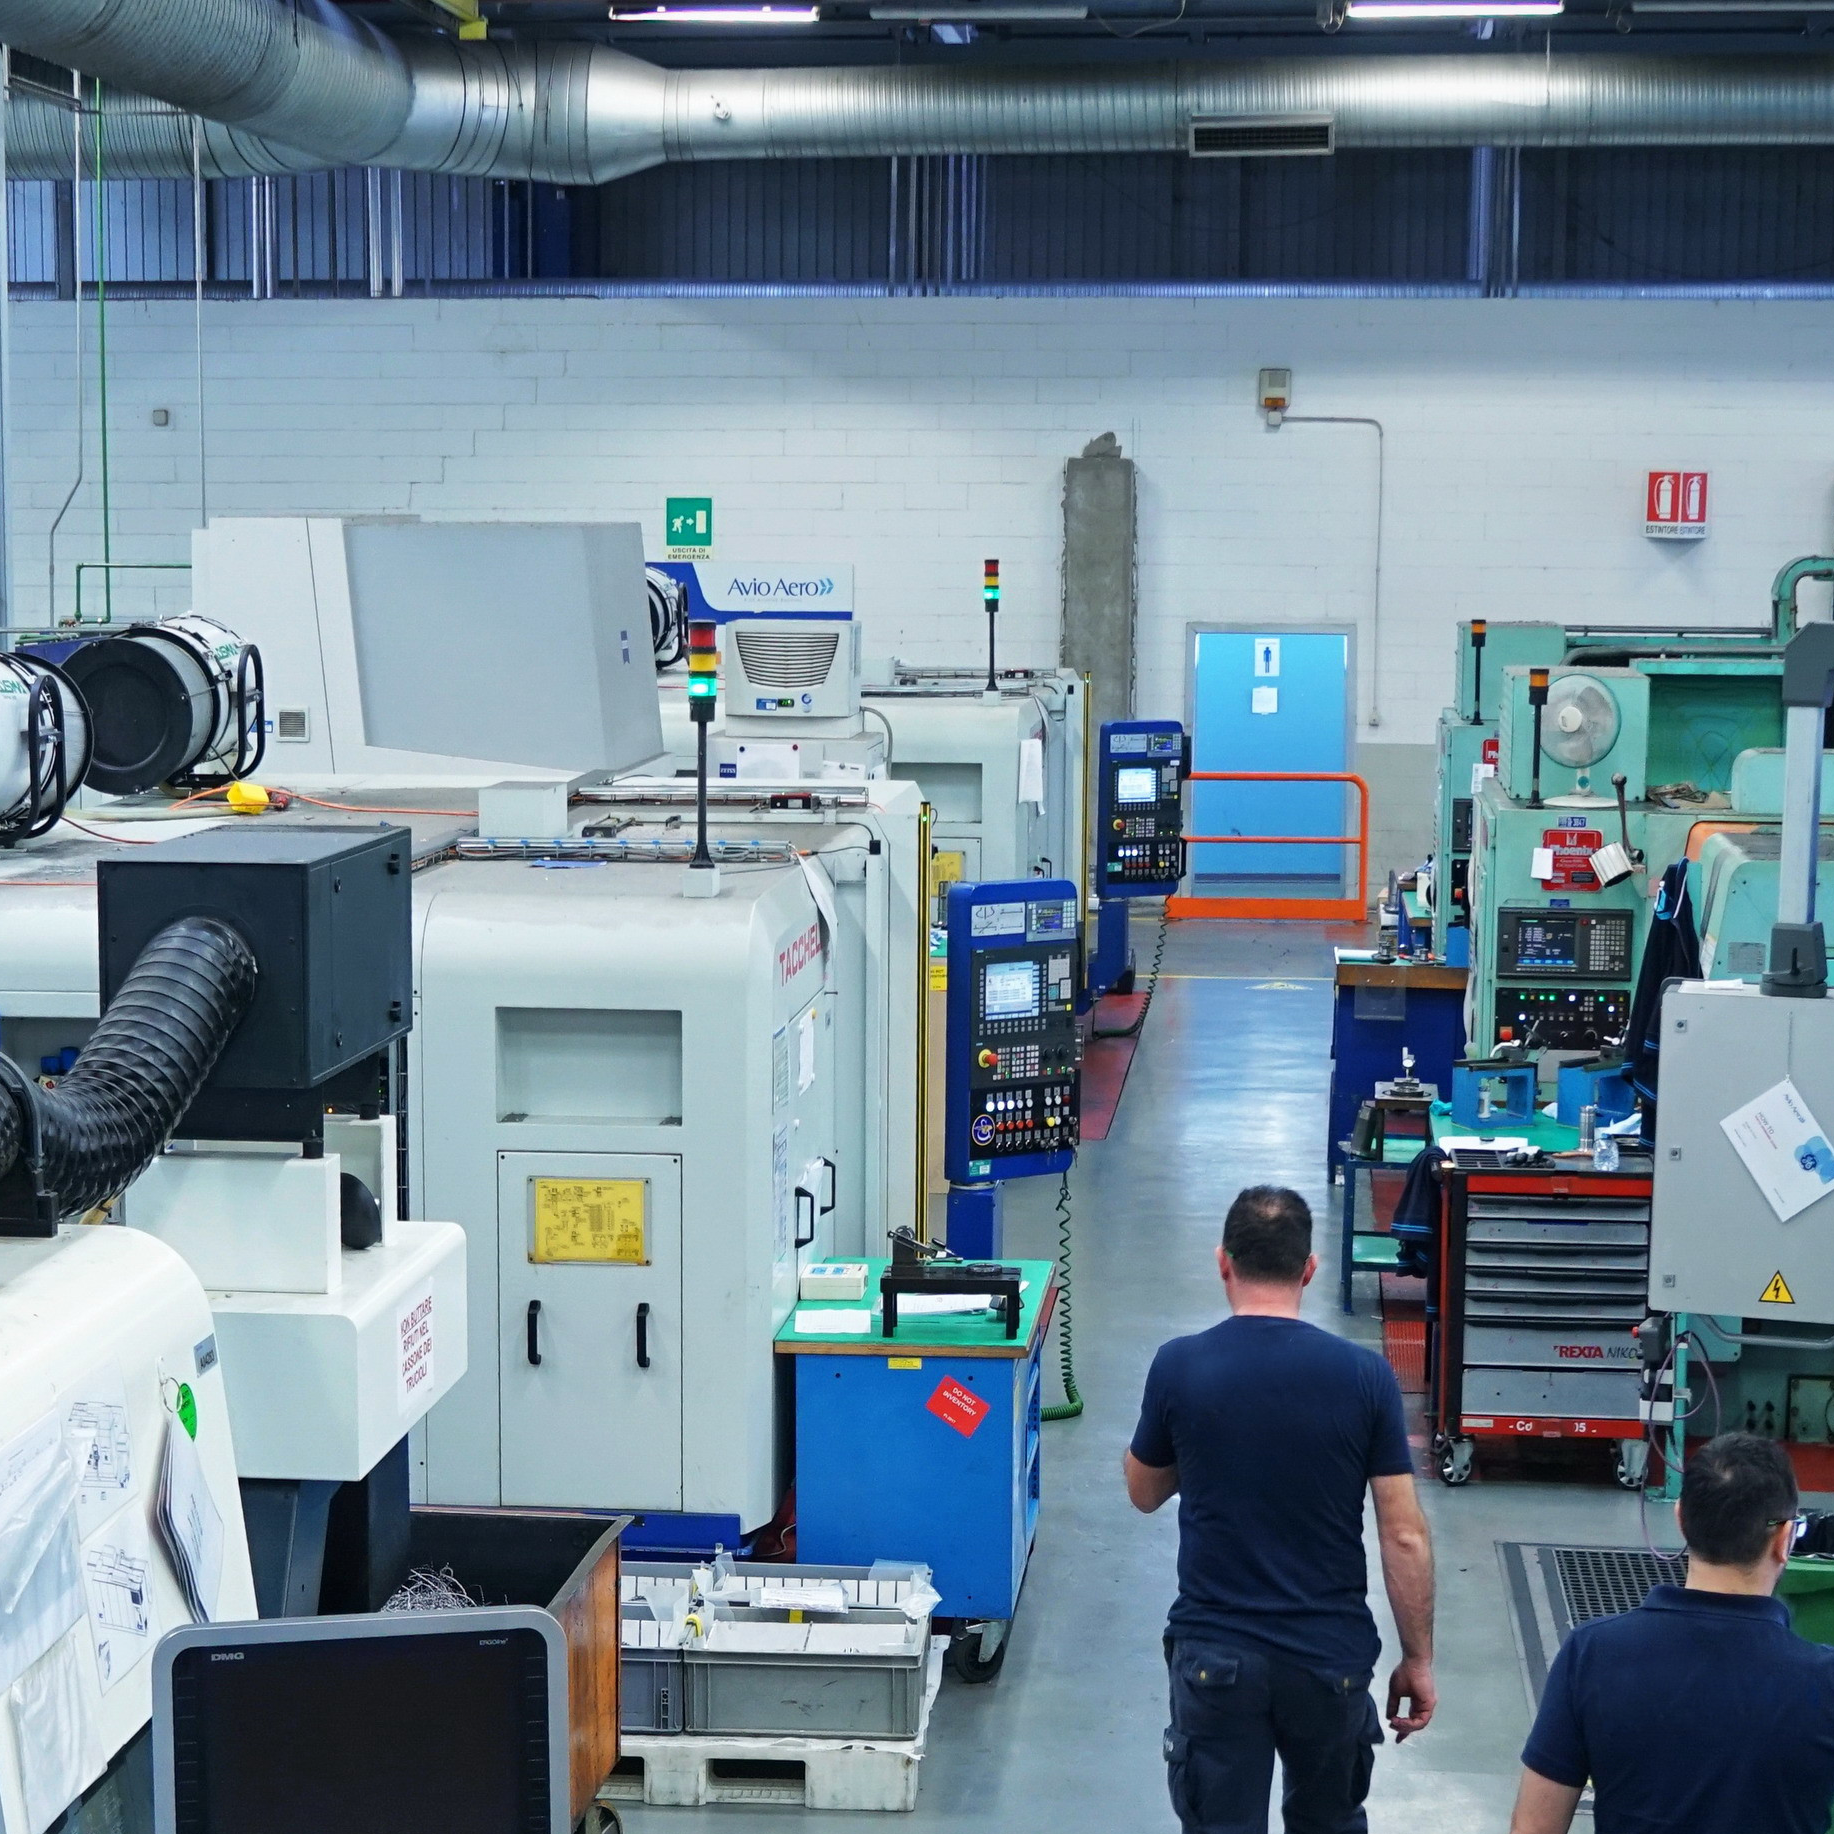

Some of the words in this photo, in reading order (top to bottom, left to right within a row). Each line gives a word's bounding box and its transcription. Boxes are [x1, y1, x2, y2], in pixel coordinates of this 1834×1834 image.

[1646, 525, 1678, 535] ESTINTORE
[727, 578, 770, 597] Avio
[773, 578, 818, 597] Aero
[1559, 1345, 1604, 1358] REXTA
[942, 1390, 977, 1416] INVENTORY
[952, 1387, 963, 1397] DO
[962, 1394, 977, 1406] NOT
[211, 1652, 244, 1661] DMG
